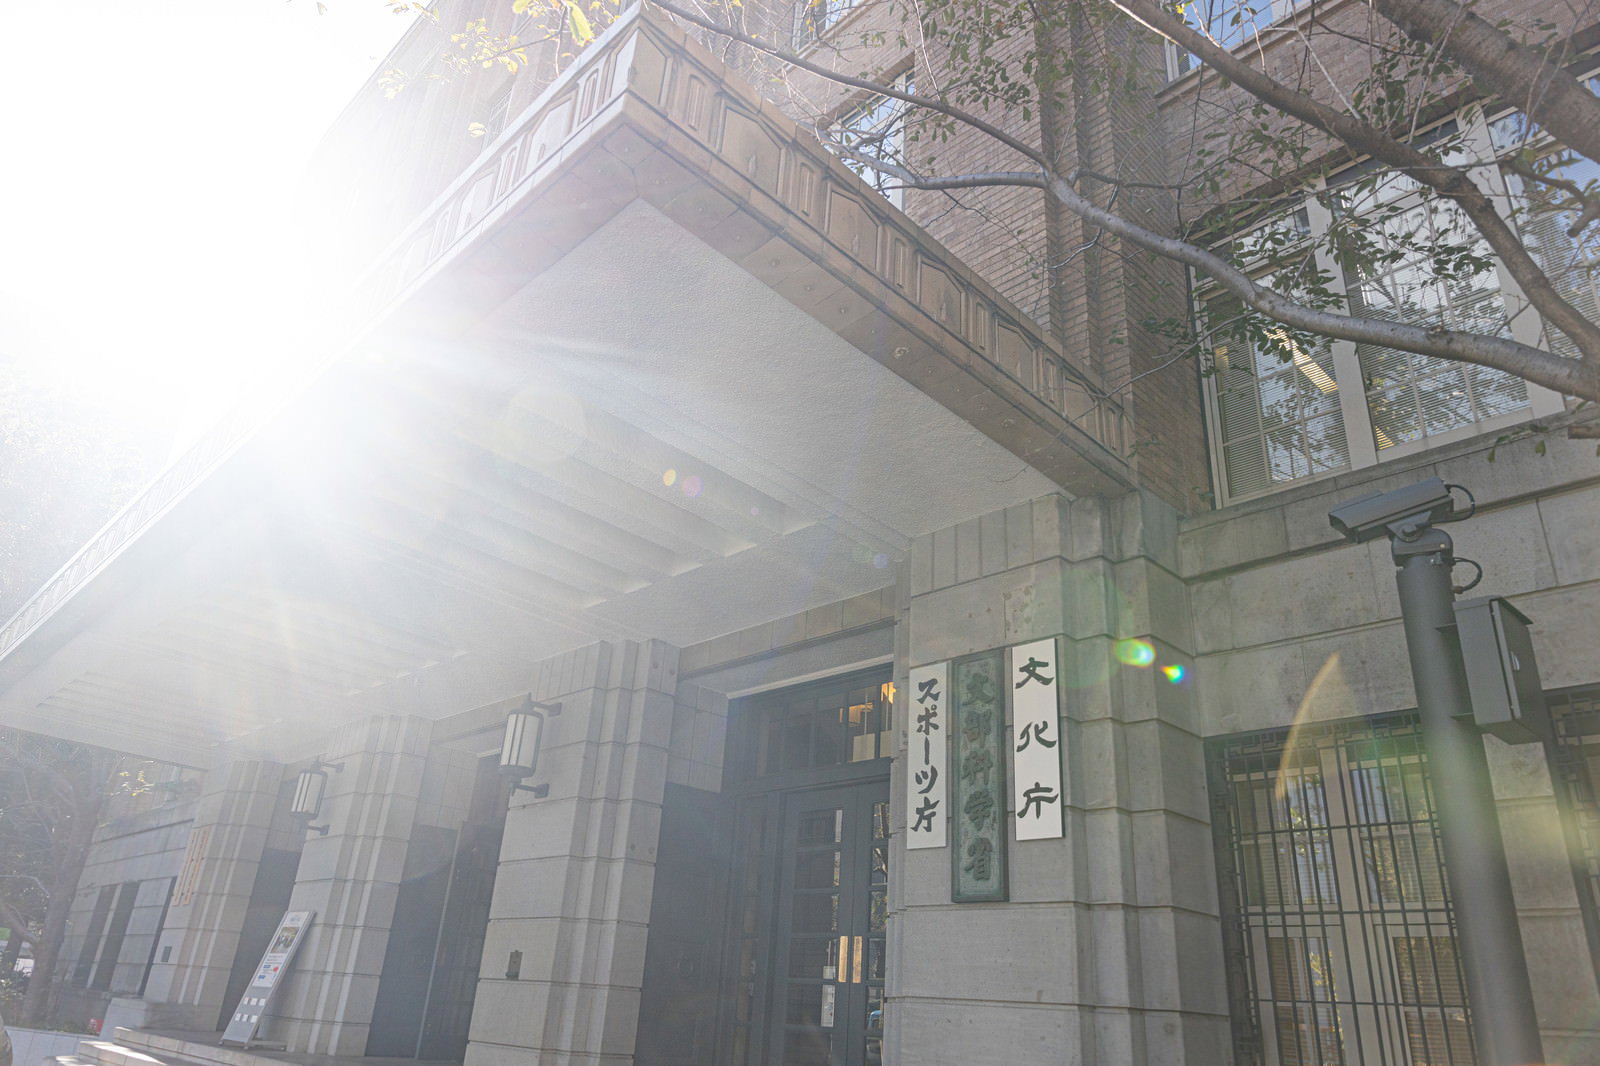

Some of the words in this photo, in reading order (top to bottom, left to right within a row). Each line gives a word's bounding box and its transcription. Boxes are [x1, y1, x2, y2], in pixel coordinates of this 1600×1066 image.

[911, 678, 941, 832] スポーツ庁
[962, 672, 994, 881] 文部科学省
[1015, 656, 1059, 819] 文化庁
